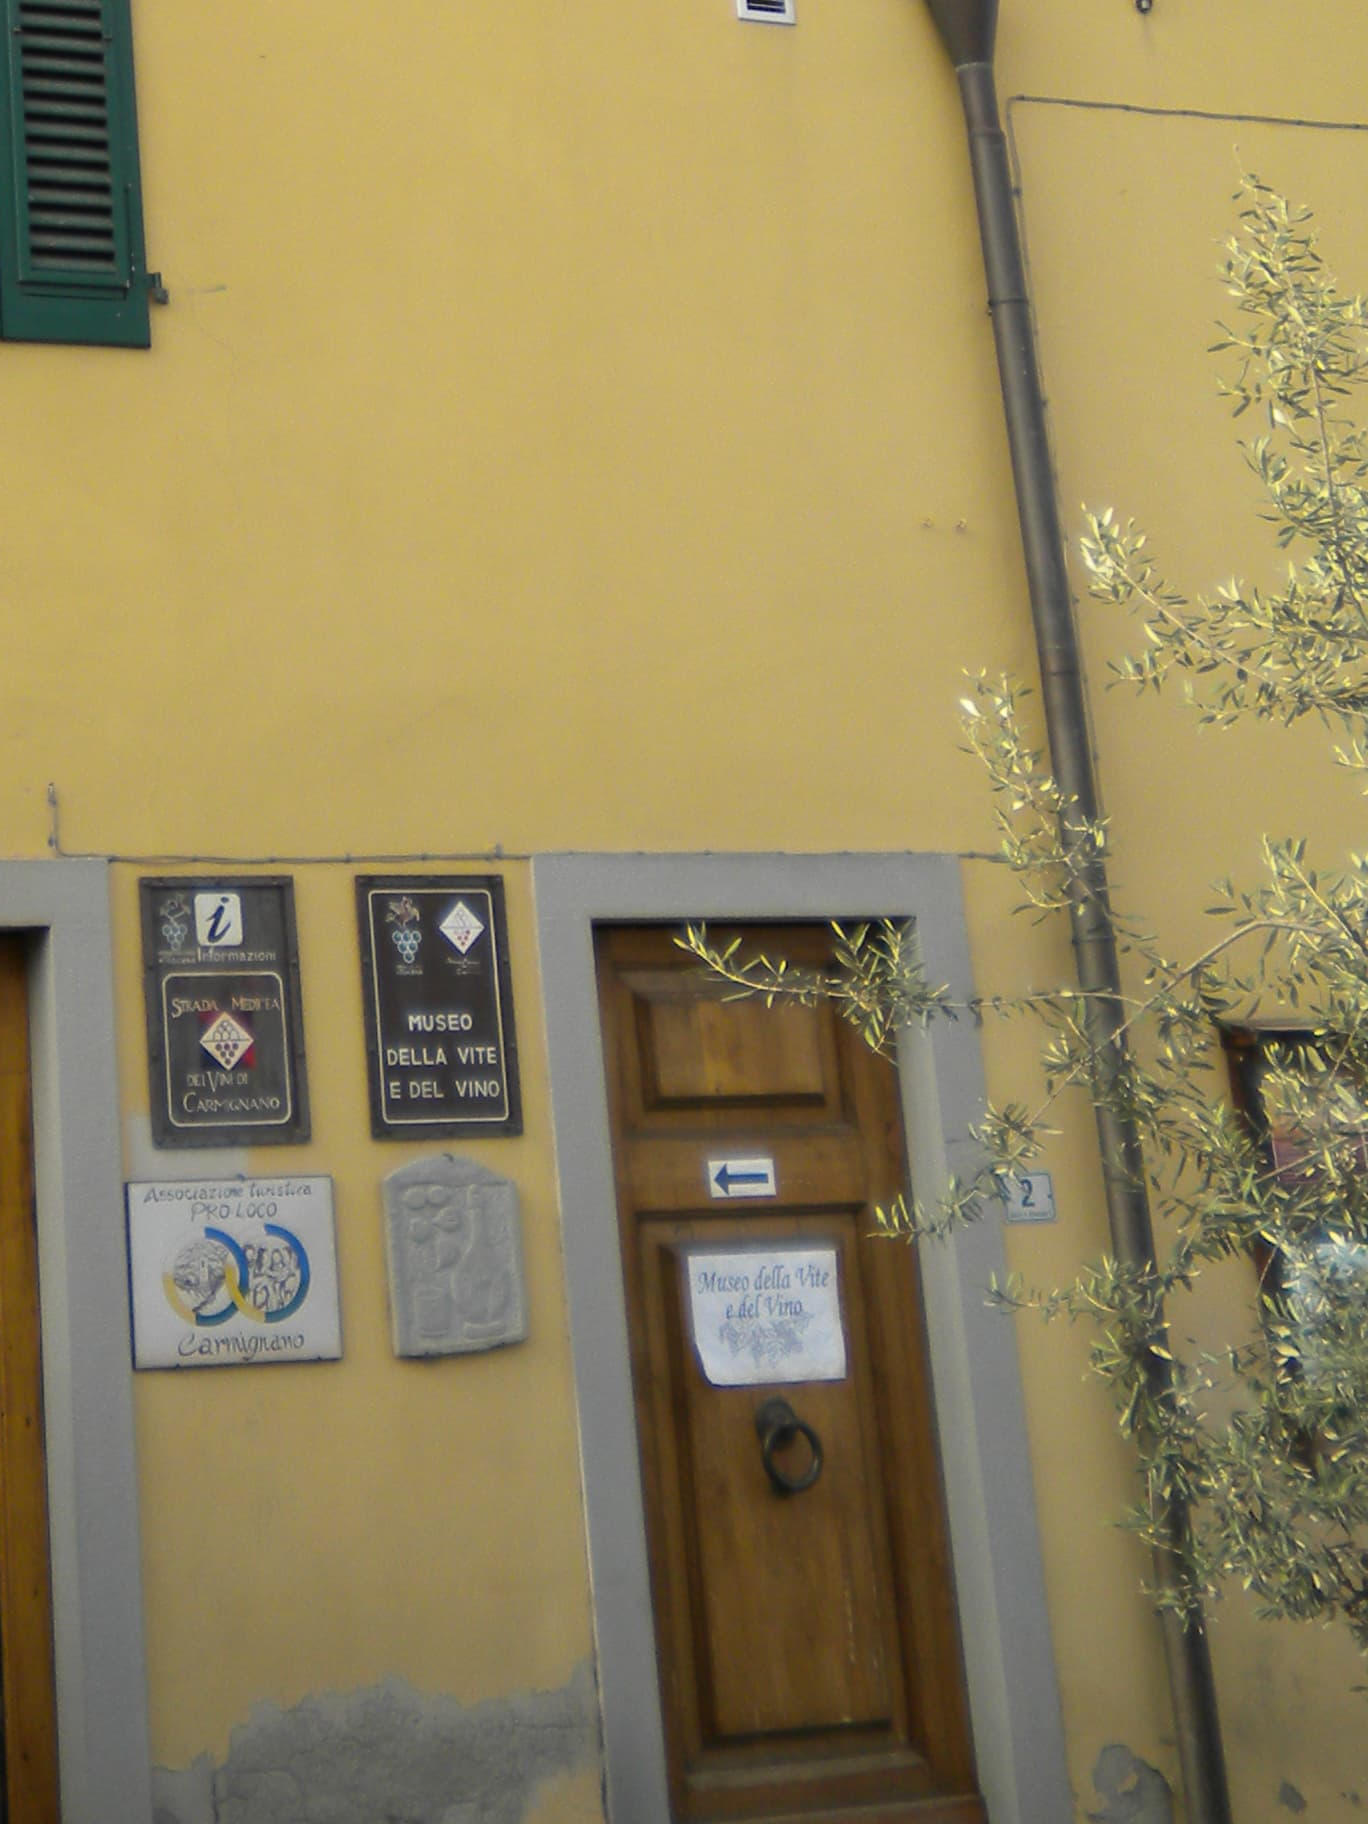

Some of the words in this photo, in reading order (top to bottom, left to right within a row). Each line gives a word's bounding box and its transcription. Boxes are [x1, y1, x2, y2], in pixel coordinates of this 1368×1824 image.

[197, 945, 277, 963] Informazioni
[171, 997, 220, 1018] STRADA
[408, 1013, 474, 1032] MUSEO
[386, 1046, 448, 1067] DELLA
[457, 1045, 498, 1065] VITE
[389, 1081, 401, 1100] E
[408, 1080, 445, 1099] DEL
[454, 1079, 501, 1099] VINO
[183, 1091, 281, 1114] CARMIGNANO
[1020, 1178, 1036, 1207] 2
[190, 1201, 231, 1223] PRO
[236, 1201, 278, 1220] LOCO
[698, 1270, 749, 1294] Museo
[754, 1265, 791, 1291] della
[795, 1264, 830, 1289] Vite
[726, 1301, 734, 1319] e
[738, 1293, 762, 1319] del
[765, 1292, 803, 1317] Vino
[177, 1331, 306, 1362] Carmignano
